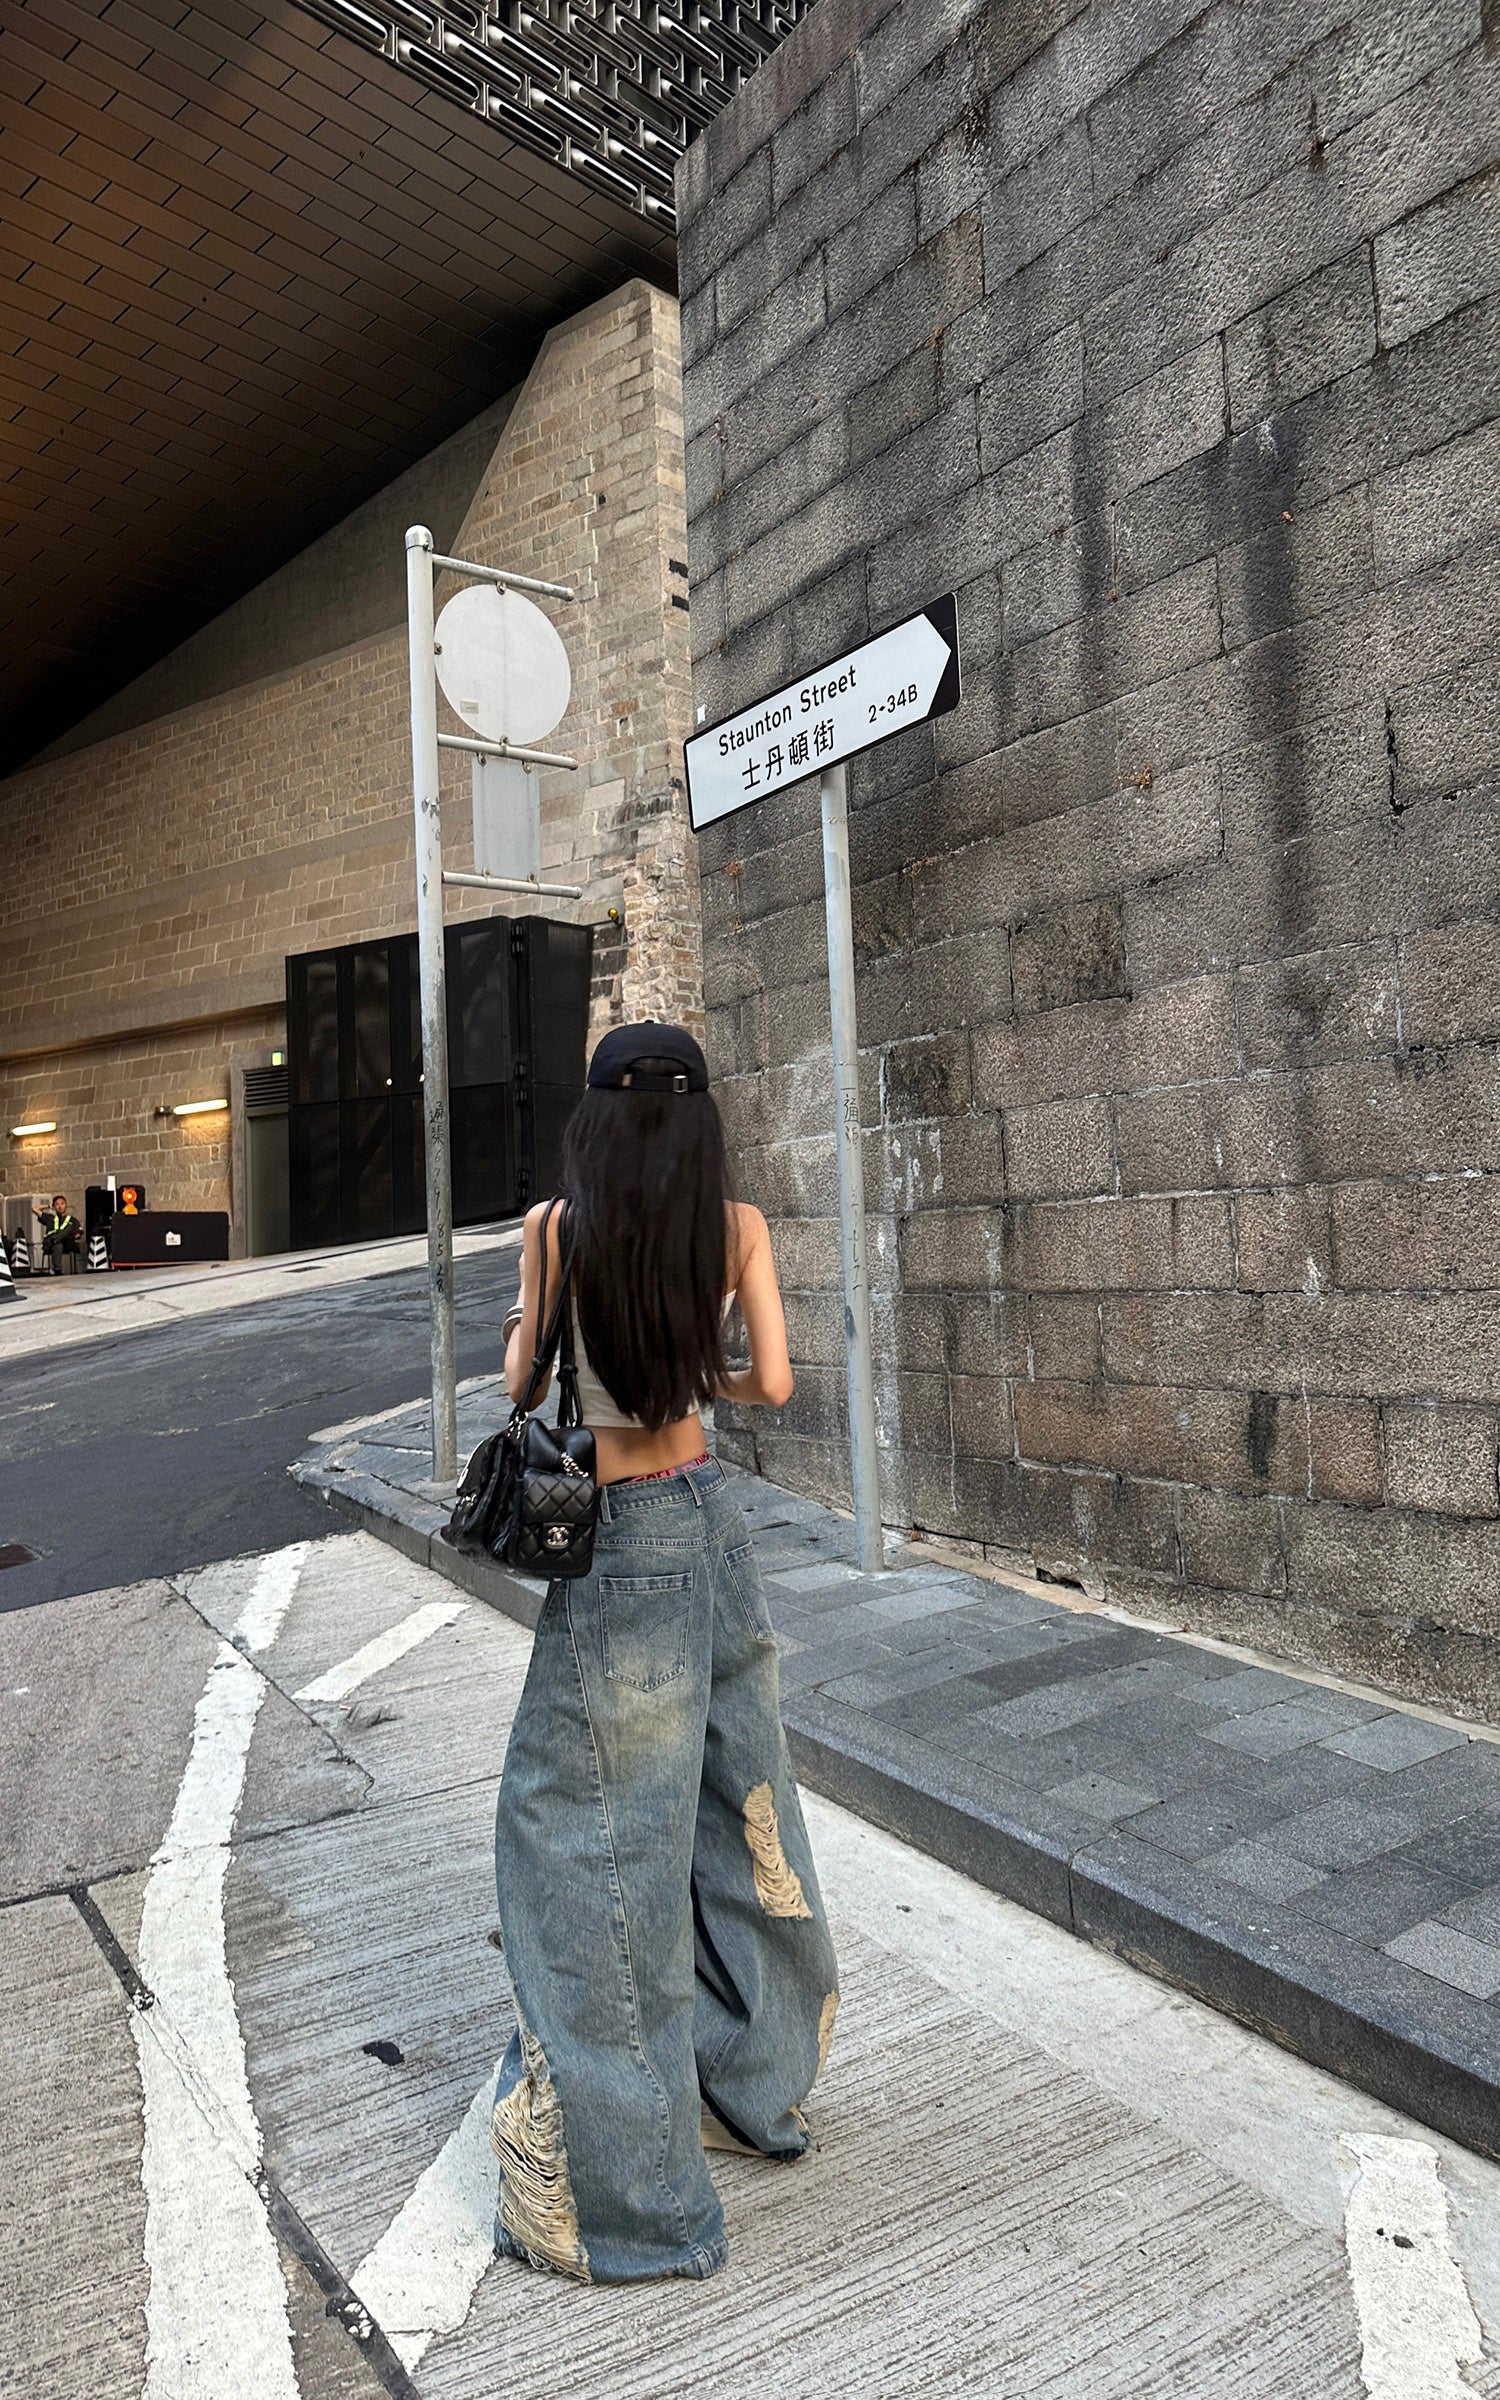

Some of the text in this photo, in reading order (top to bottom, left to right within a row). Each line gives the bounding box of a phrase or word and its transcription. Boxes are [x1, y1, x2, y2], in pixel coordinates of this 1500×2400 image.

[718, 664, 858, 757] Staunton Street
[741, 717, 835, 791] 士丹頓街
